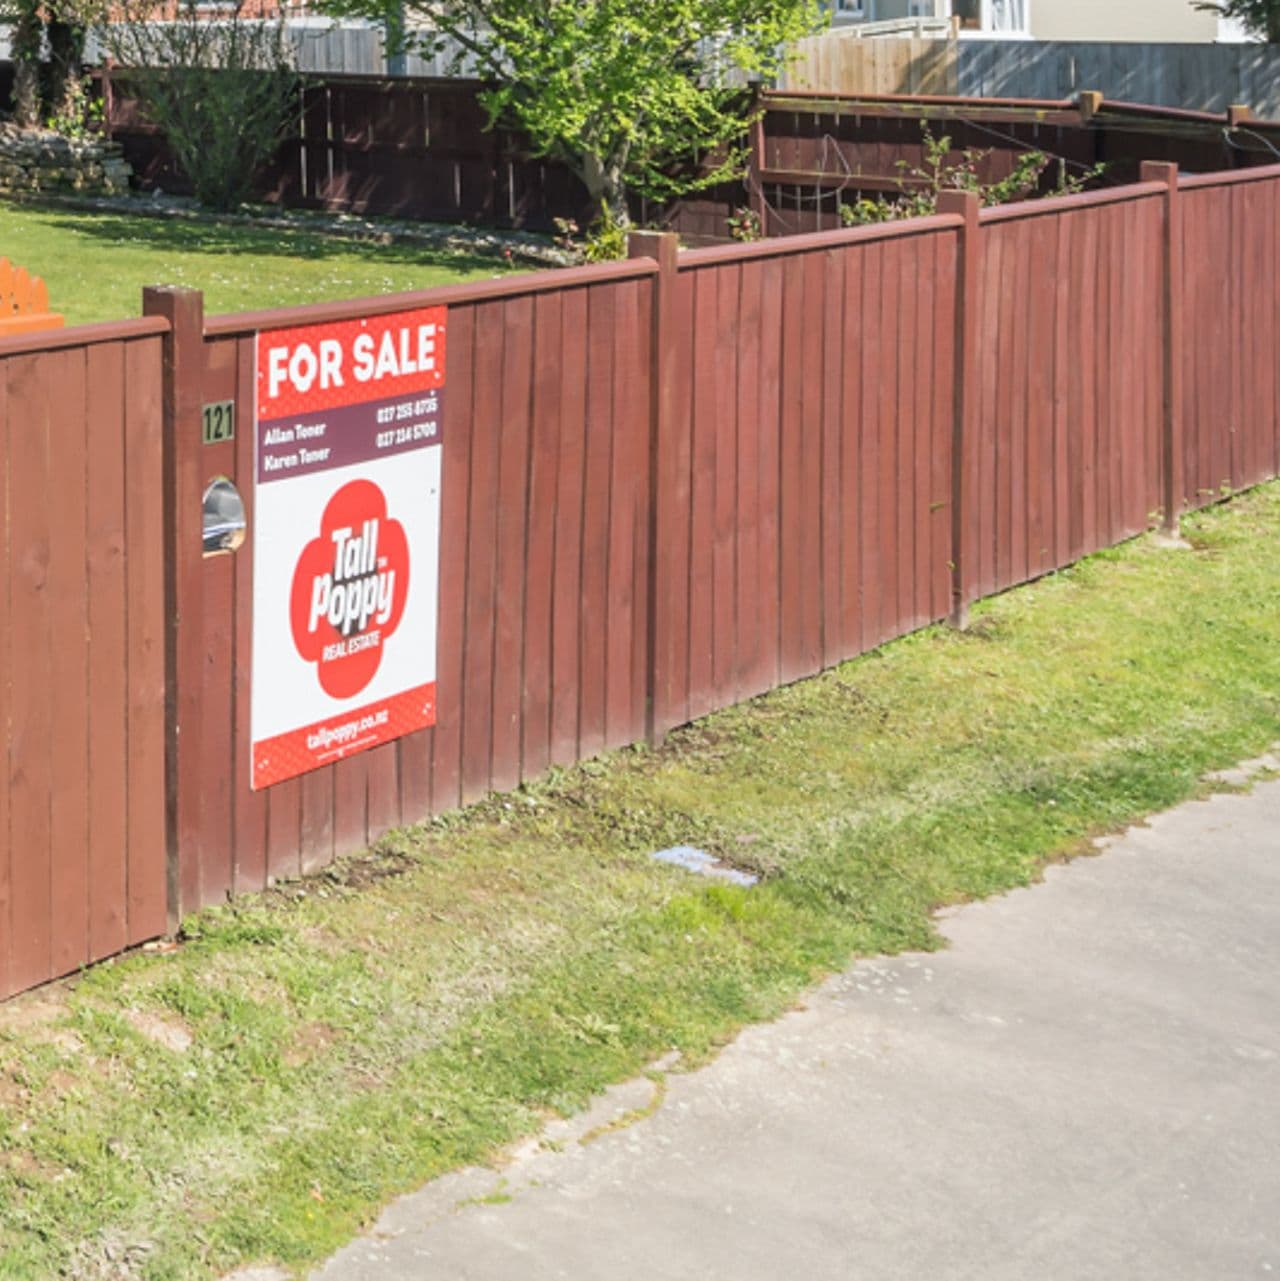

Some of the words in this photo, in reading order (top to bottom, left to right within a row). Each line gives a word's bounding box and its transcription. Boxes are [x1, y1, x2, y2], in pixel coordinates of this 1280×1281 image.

[269, 340, 344, 397] FOR
[353, 324, 435, 382] SALE
[204, 404, 233, 440] 121
[264, 428, 294, 446] Allan
[264, 452, 298, 471] Karen
[331, 519, 379, 581] Tall
[323, 640, 348, 662] REAL
[348, 630, 381, 655] ESTATE
[307, 710, 389, 749] tallpoppy.co.nz
